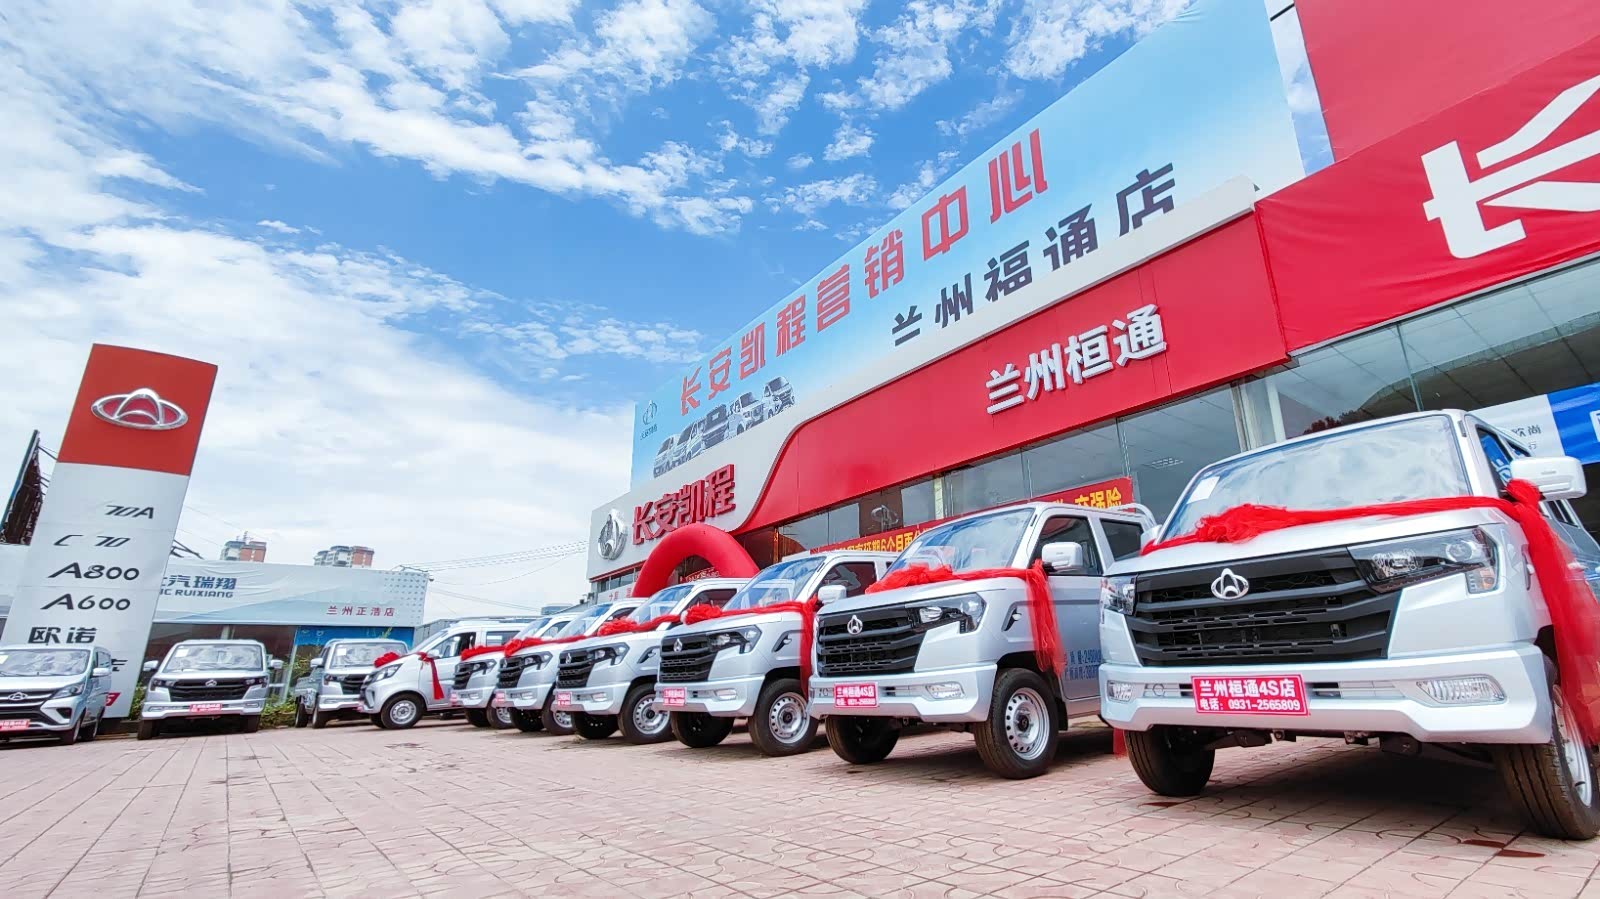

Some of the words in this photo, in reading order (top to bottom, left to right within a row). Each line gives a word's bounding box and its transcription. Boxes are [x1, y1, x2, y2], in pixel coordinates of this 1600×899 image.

[891, 162, 1175, 347] 兰州福通店
[680, 128, 1048, 416] 长安凯程营销中心
[984, 303, 1168, 416] 兰州桓通
[632, 464, 737, 545] 长安凯程
[47, 562, 140, 580] A800
[161, 574, 238, 590] 汽瑞翔
[40, 593, 131, 610] A600
[175, 589, 234, 598] RUIXIANG
[27, 626, 98, 645] 欧诺
[1199, 678, 1296, 698] 兰州桓通4S店
